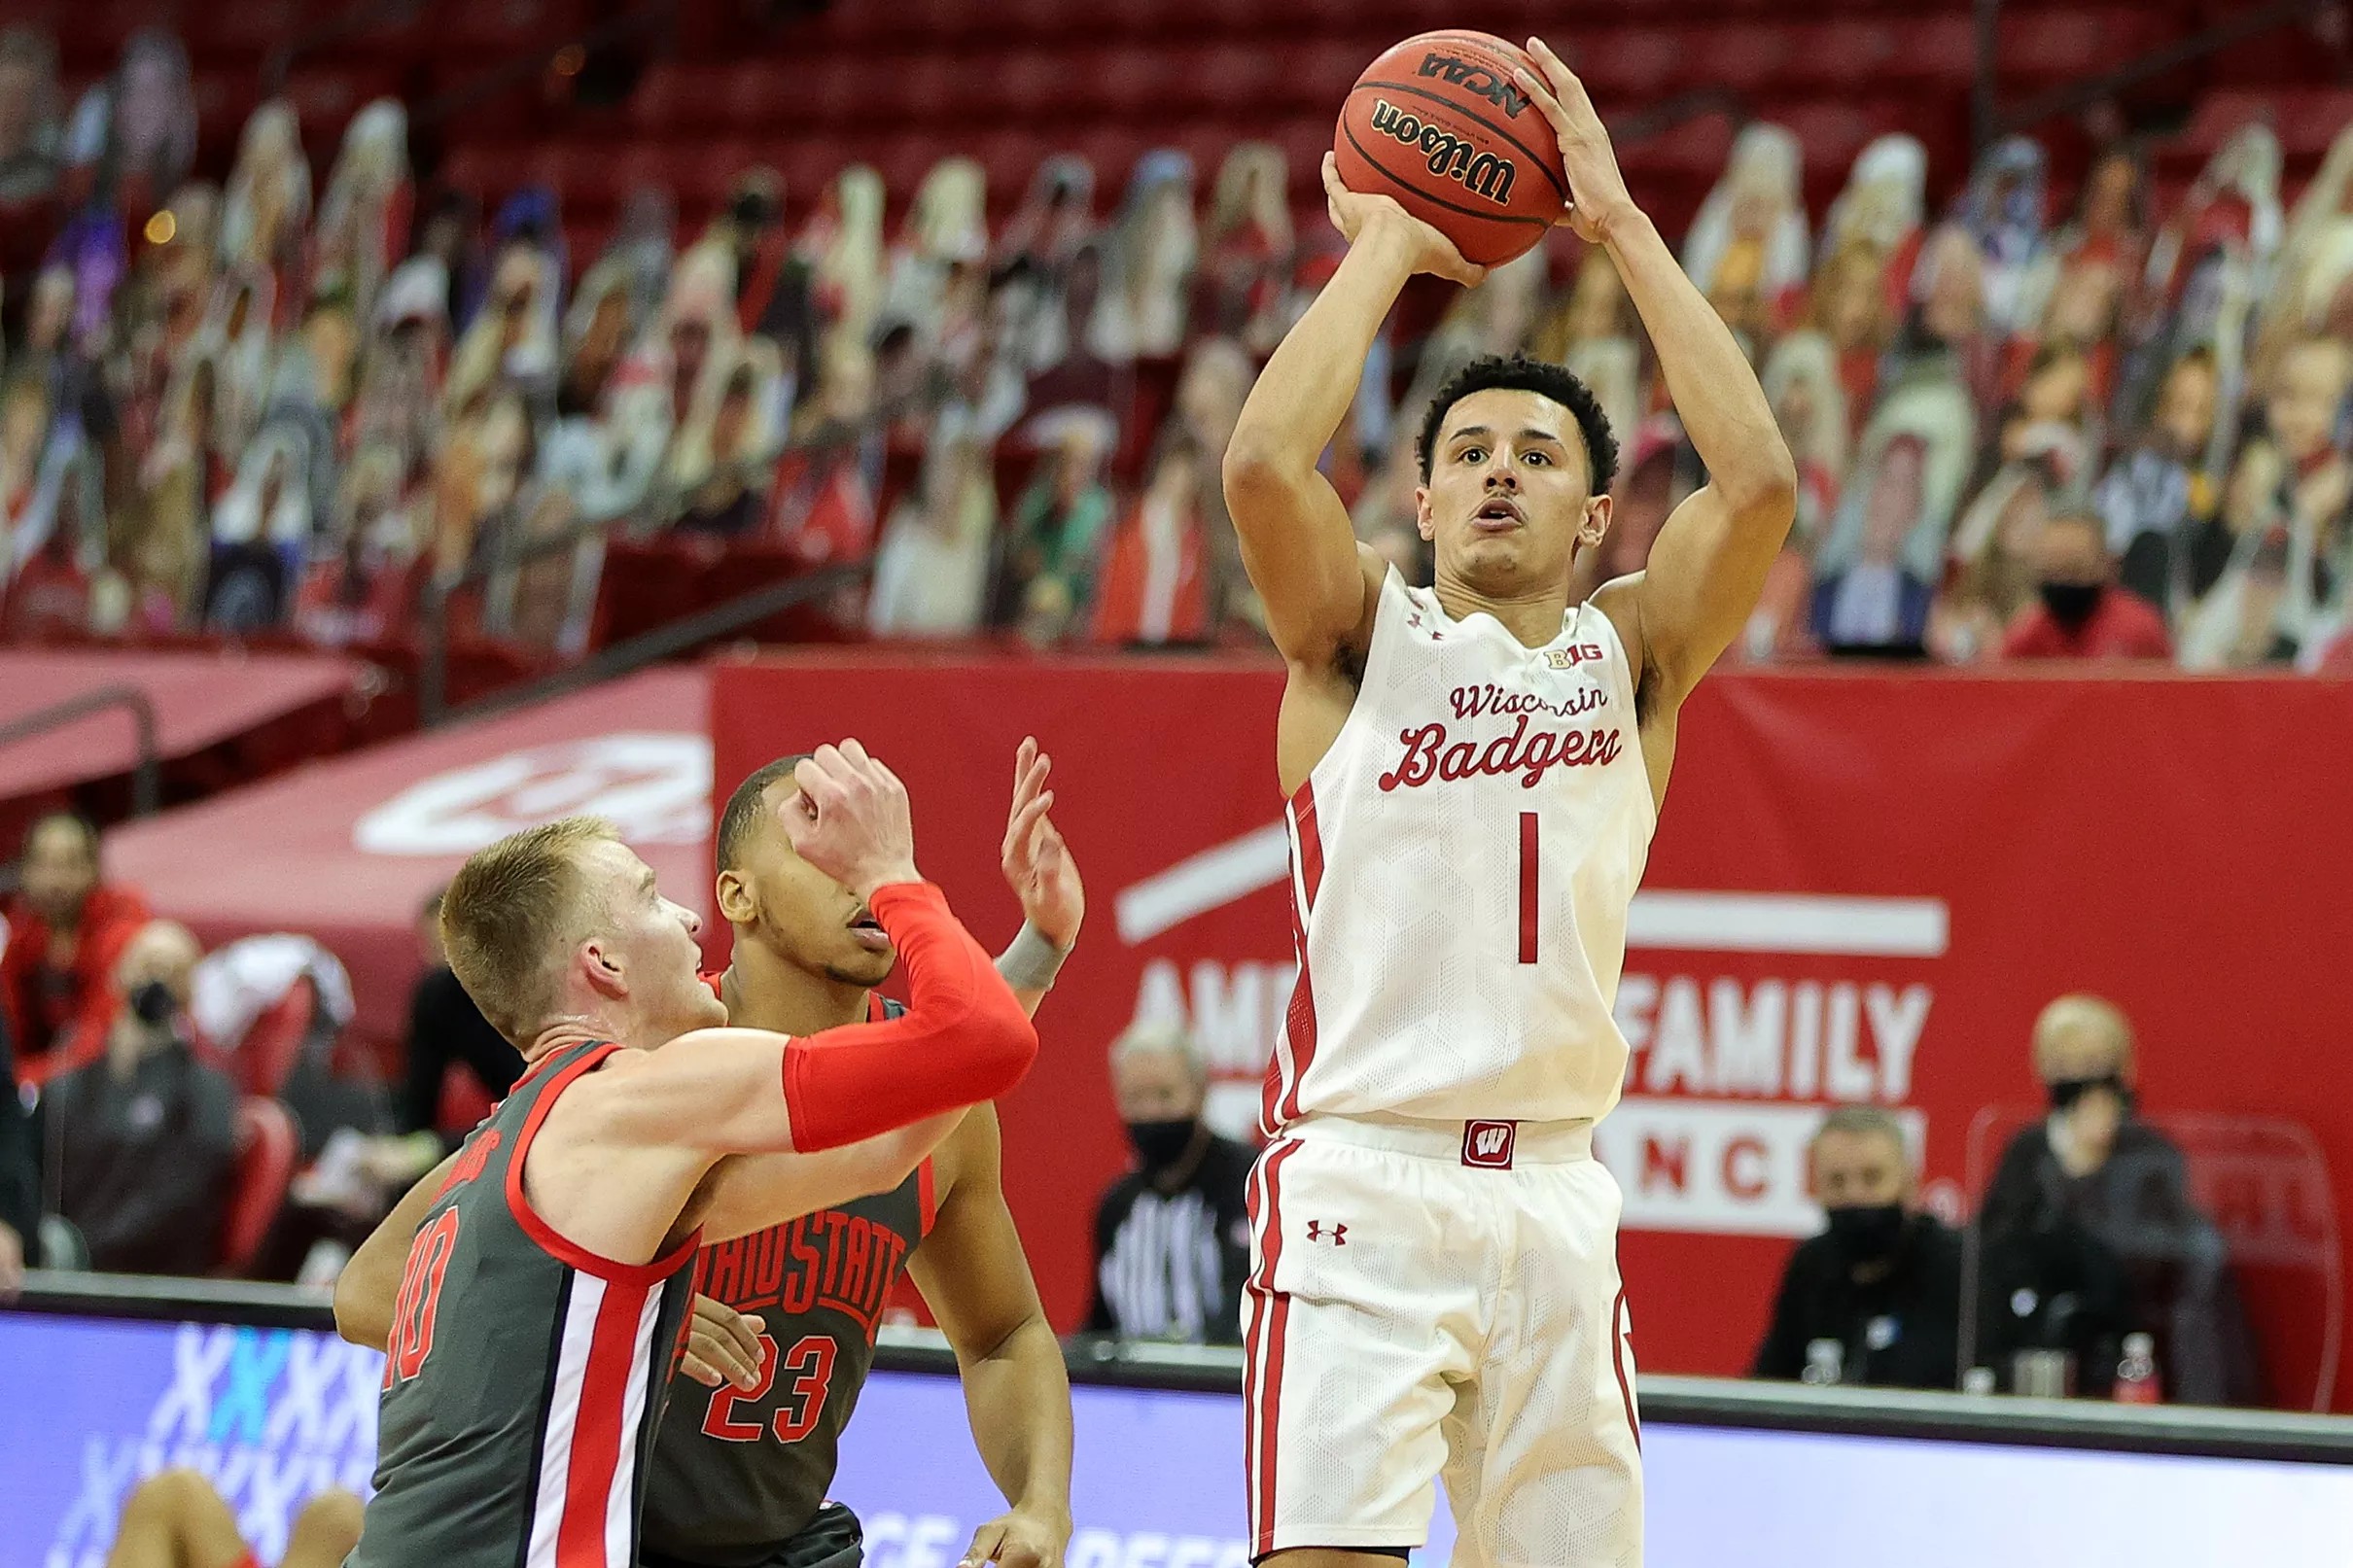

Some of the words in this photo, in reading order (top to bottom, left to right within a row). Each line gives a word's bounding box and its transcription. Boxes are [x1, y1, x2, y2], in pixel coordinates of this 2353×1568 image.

[1418, 52, 1531, 120] NCAA
[1370, 98, 1518, 207] Wilson
[1378, 714, 1623, 792] Badgers
[1518, 812, 1539, 964] 1
[1614, 973, 1934, 1103] FAMILY
[382, 1204, 460, 1392] 10
[700, 1333, 839, 1444] 23
